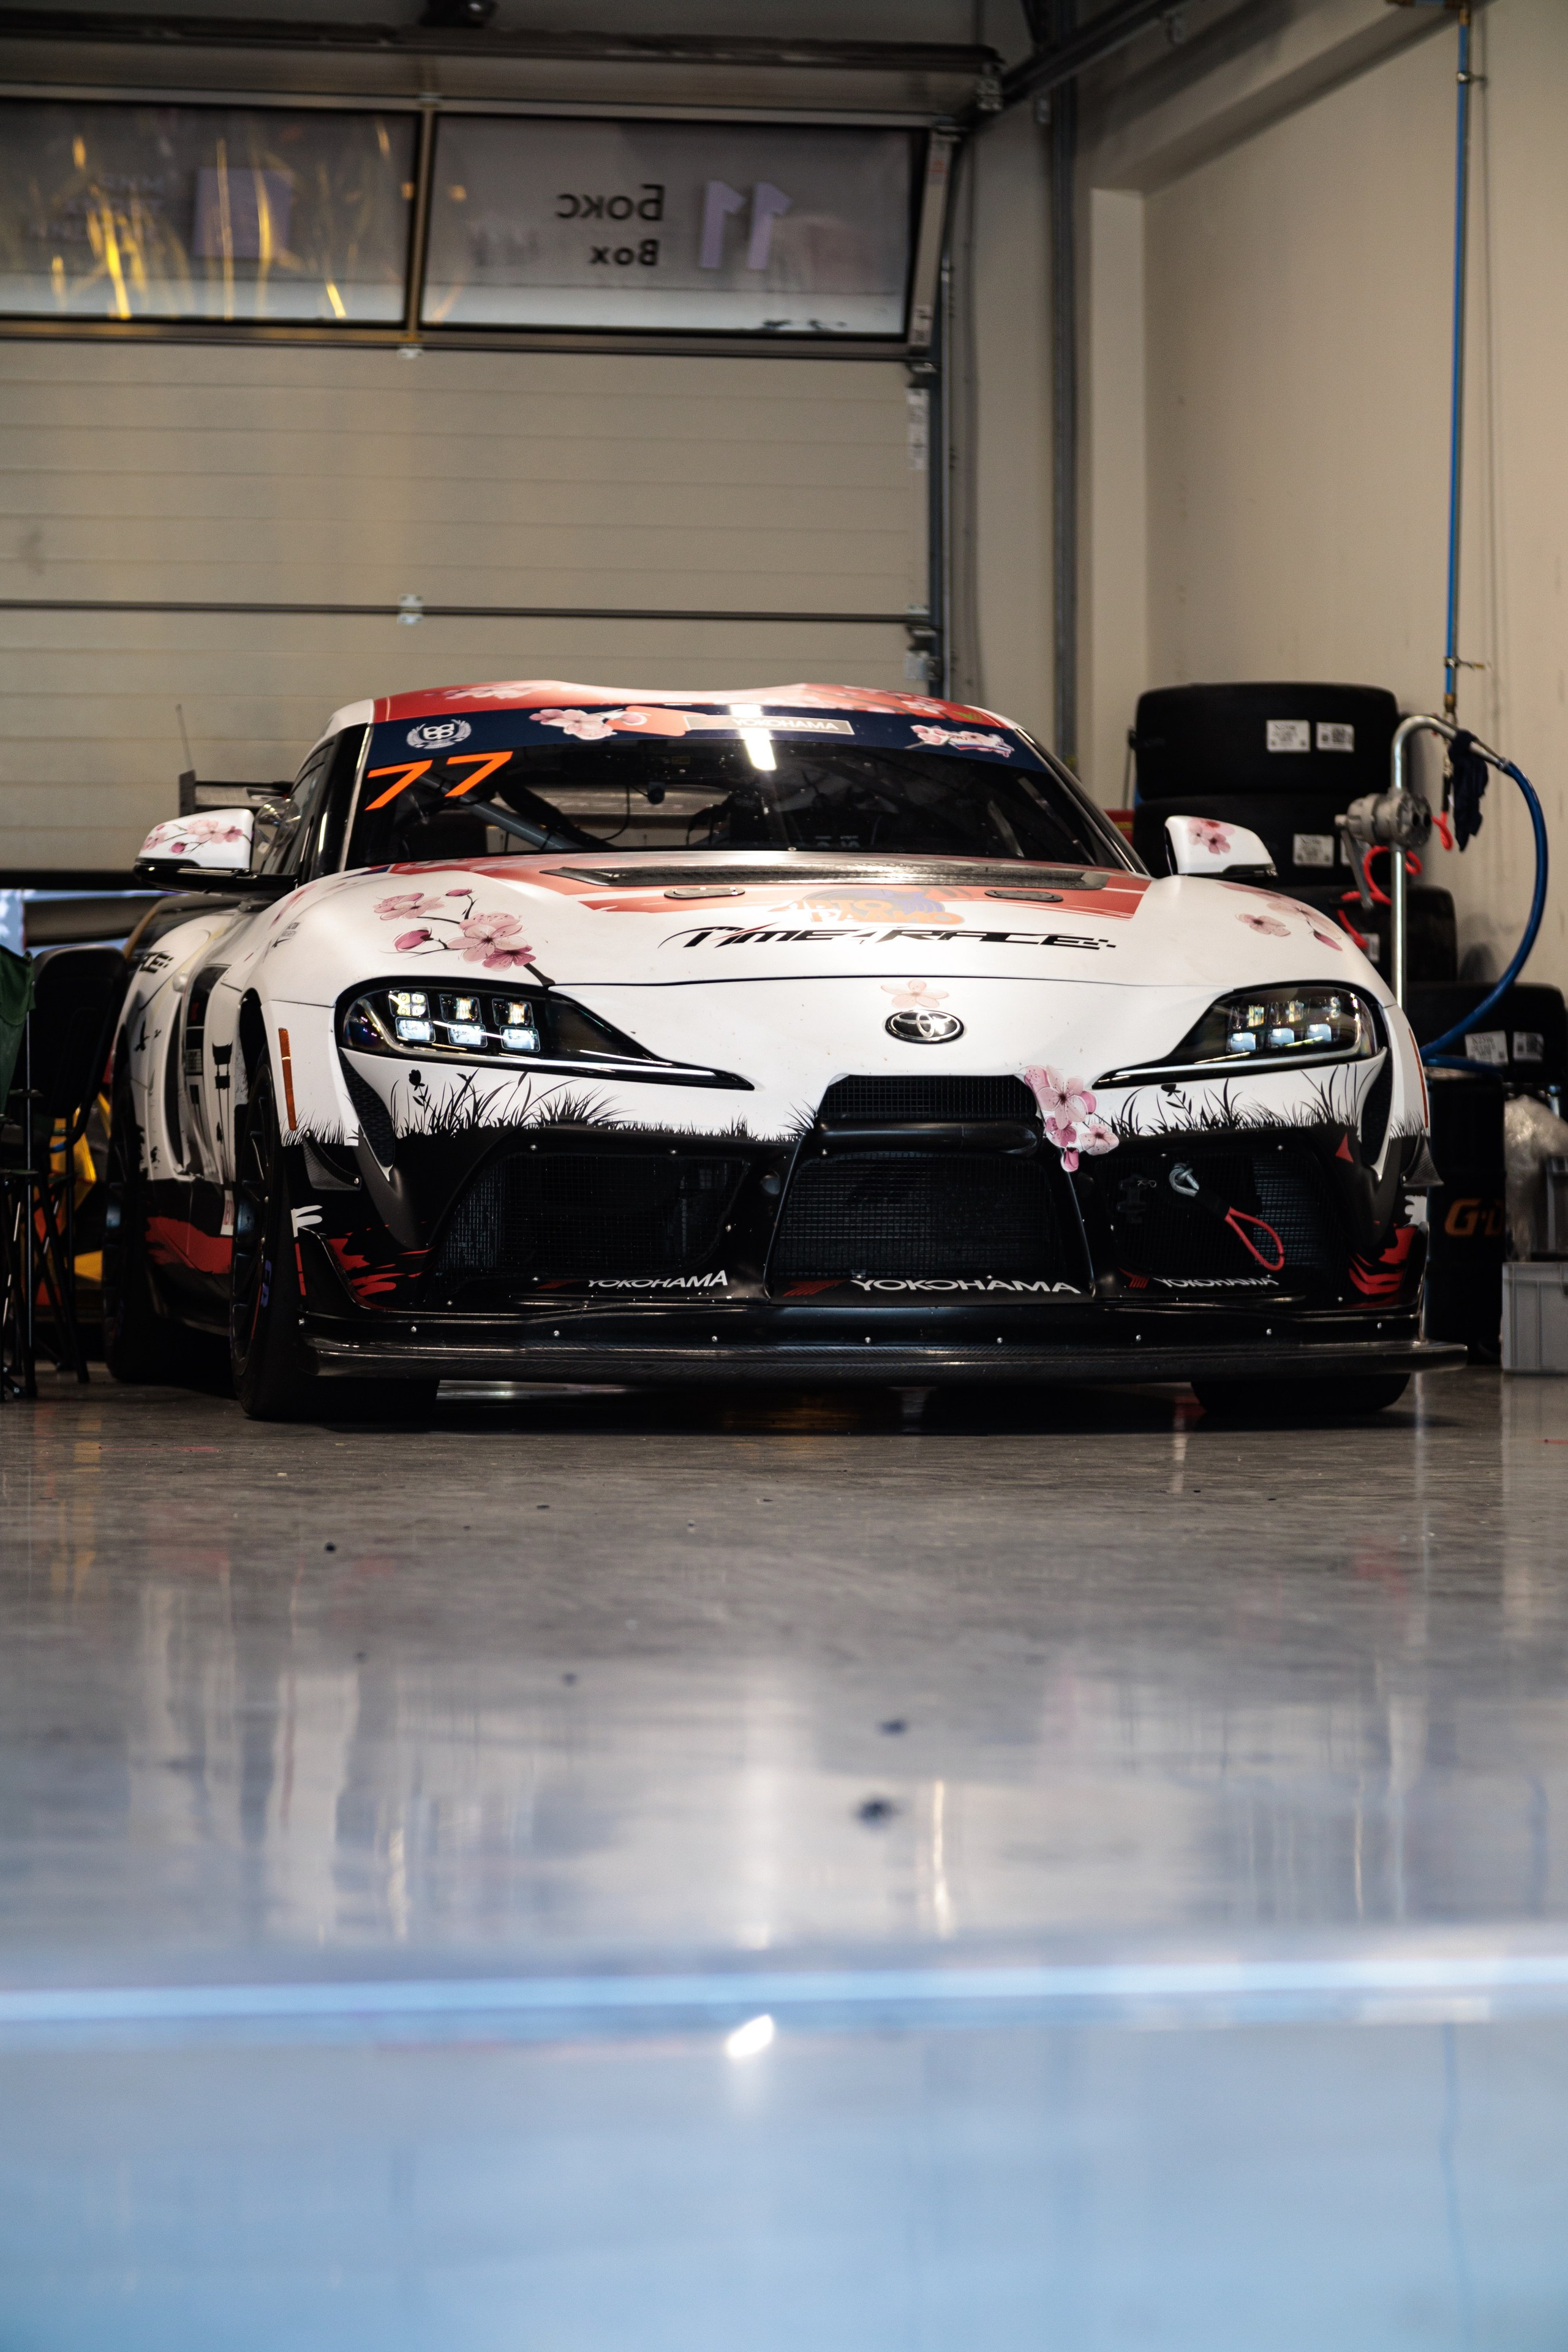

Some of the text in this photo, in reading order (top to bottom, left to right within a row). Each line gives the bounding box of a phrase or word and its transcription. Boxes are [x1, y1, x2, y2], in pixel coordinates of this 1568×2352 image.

[731, 717, 840, 730] YOKOHAMA
[364, 751, 513, 811] 77
[588, 1270, 728, 1287] YOKOHAMA
[1154, 1276, 1279, 1287] YOKOHAMA
[850, 1279, 1081, 1294] YOKOHAMA
